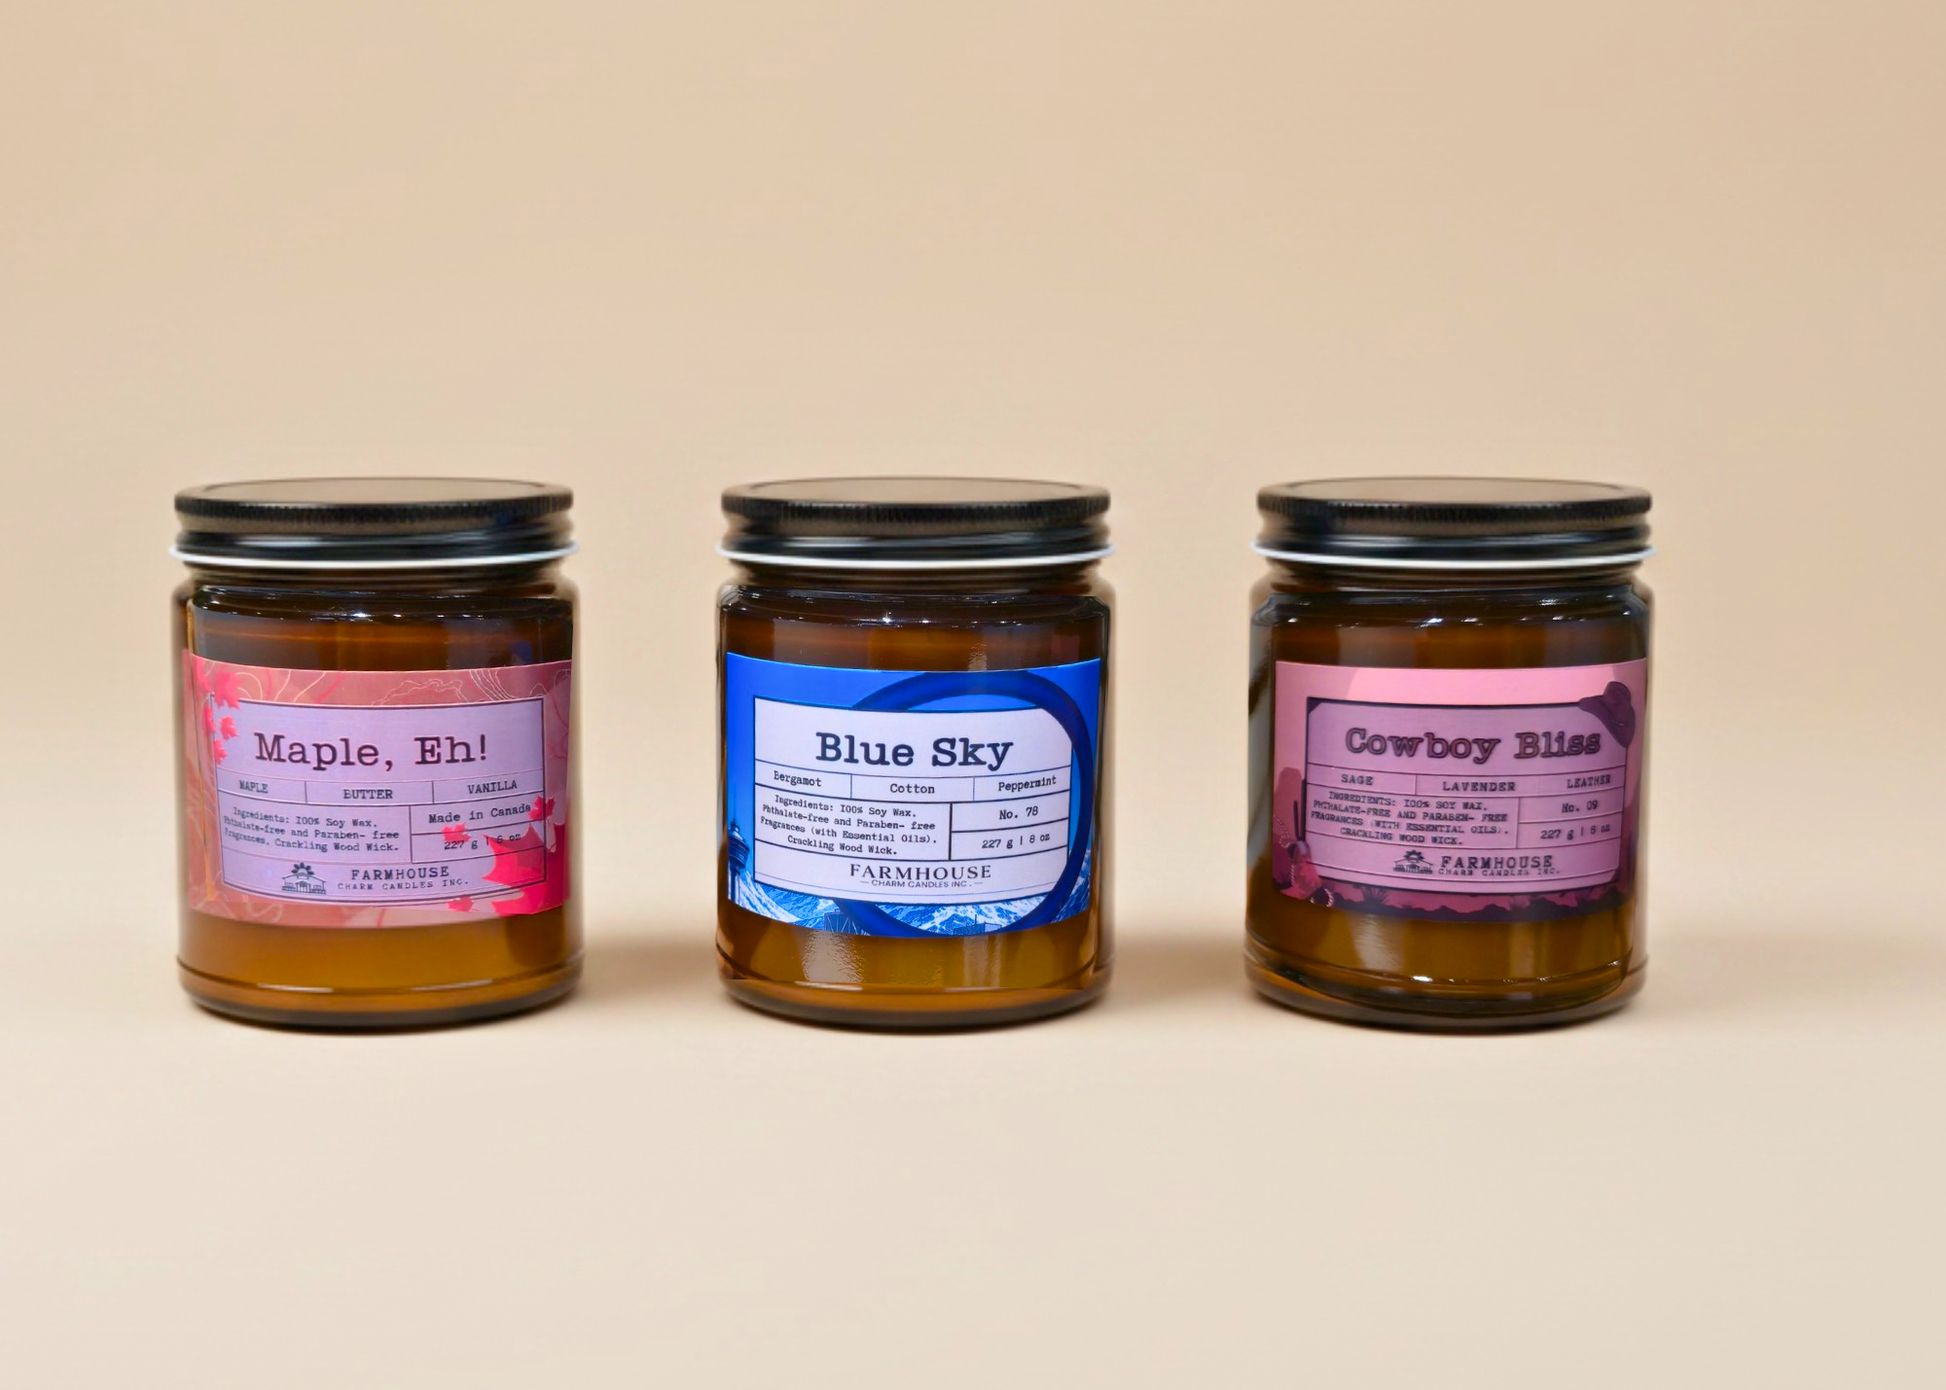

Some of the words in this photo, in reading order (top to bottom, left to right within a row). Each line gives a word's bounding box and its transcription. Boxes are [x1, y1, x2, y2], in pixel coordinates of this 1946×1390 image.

[254, 732, 393, 771] Maple,
[414, 734, 487, 765] Eh!
[816, 732, 914, 767] Blue
[932, 737, 1014, 771] Sky
[1345, 727, 1502, 765] Cowboy
[1514, 731, 1601, 759] Bliss
[773, 770, 821, 787] Bergamot
[998, 776, 1057, 792] Peppermint
[1341, 774, 1374, 786] SAGE
[1442, 781, 1516, 792] LAVENDER
[1567, 774, 1611, 789] LEATHER
[239, 780, 269, 794] MAPLE
[343, 789, 393, 799] BUTTER
[468, 780, 518, 795] VANILLA
[890, 784, 935, 794] Cotton
[775, 795, 834, 811] Ingredients:
[869, 808, 887, 818] Soy
[893, 808, 916, 818] Wax.
[1329, 791, 1396, 806] INGREDIENTS:
[1435, 801, 1456, 810] SOY
[1462, 802, 1487, 810] WAX.
[1561, 803, 1580, 813] No.
[1586, 800, 1598, 810] 09
[232, 807, 290, 824] Ingredients:
[326, 818, 346, 829] Soy
[352, 819, 377, 827] Wax.
[429, 812, 461, 824] Made
[469, 811, 483, 820] in
[491, 804, 531, 818] Canada
[763, 804, 829, 824] Phthalate-free
[834, 817, 851, 826] and
[911, 822, 936, 830] free
[999, 809, 1019, 820] No.
[1025, 806, 1039, 817] 78
[1397, 811, 1417, 820] AND
[1481, 814, 1507, 822] FREE
[760, 816, 806, 833] Fragrances
[811, 827, 837, 838] (with
[842, 831, 895, 842] Essential
[901, 834, 937, 843] Oils).
[1311, 811, 1364, 825] FRAGRANCES
[1406, 823, 1464, 833] ESSENTIAL
[1471, 825, 1508, 834] OILS).
[291, 829, 309, 837] and
[372, 830, 399, 839] free
[1340, 828, 1393, 841] CRACKLING
[1399, 834, 1425, 843] WOOD
[1431, 836, 1463, 845] WICK.
[1540, 830, 1561, 839] 227
[1567, 830, 1574, 841] g
[1601, 824, 1611, 833] oz
[275, 839, 328, 853] Crackling
[334, 842, 360, 851] Wood
[366, 843, 399, 851] Wick.
[444, 841, 464, 850] 227
[471, 841, 478, 849] g
[509, 834, 521, 842] oz
[787, 835, 835, 851] Crackling
[839, 842, 863, 852] Wood
[868, 845, 897, 855] Wick.
[981, 839, 1001, 849] 227
[1007, 839, 1013, 849] g
[1029, 835, 1035, 843] 8
[1040, 833, 1050, 841] oz
[1441, 855, 1553, 868] FARMHOUSE
[351, 866, 449, 880] FARMHOUSE
[850, 864, 991, 880] FARMHOUSE
[382, 881, 433, 890] CANDLES
[443, 878, 469, 887] INC.
[908, 880, 949, 888] CANDLES
